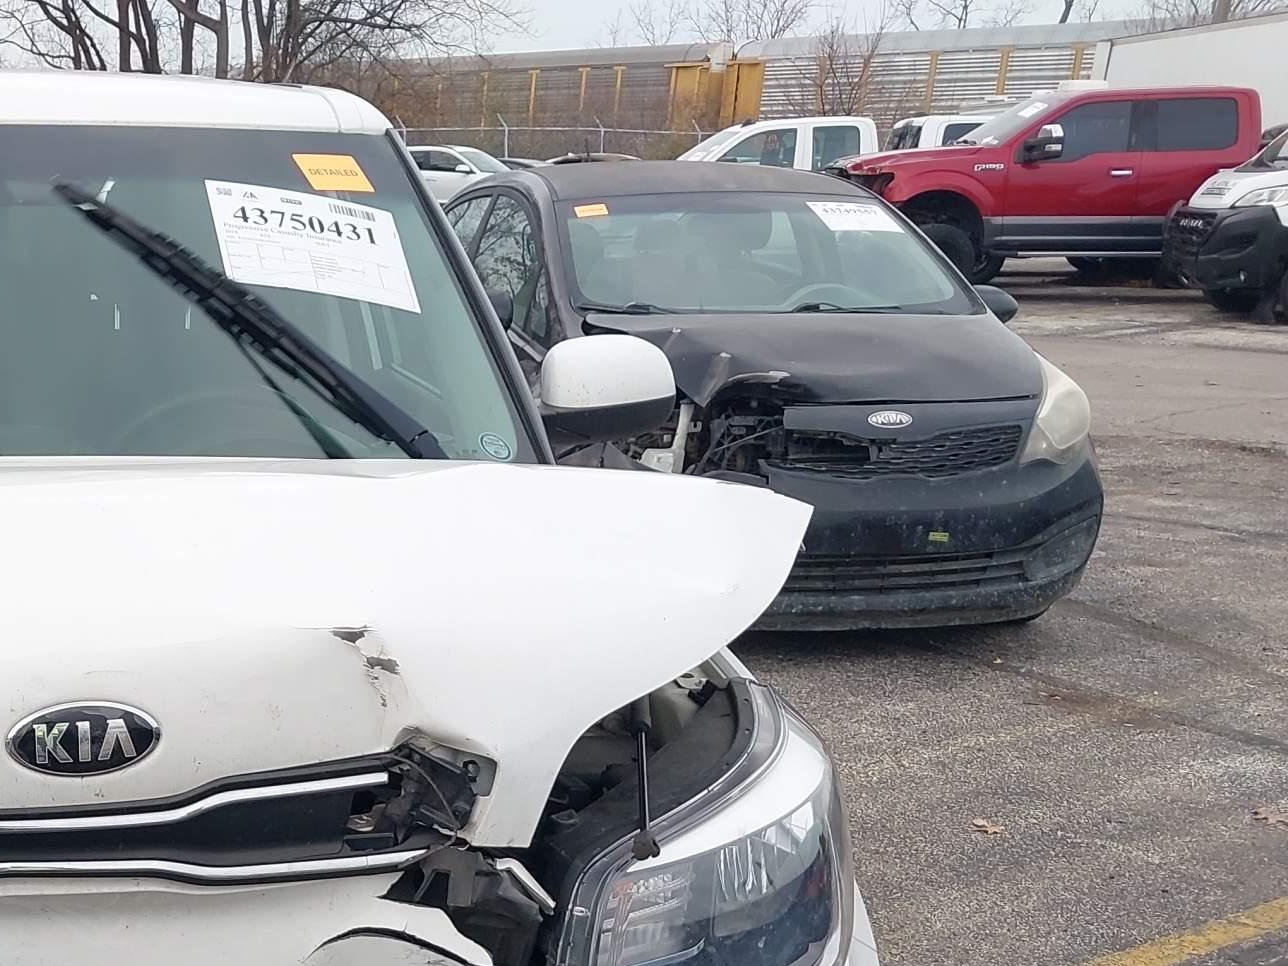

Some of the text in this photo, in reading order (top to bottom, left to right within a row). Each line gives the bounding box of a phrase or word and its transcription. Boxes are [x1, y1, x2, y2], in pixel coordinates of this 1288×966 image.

[308, 167, 359, 178] DETAILED
[232, 205, 379, 246] 43750431
[32, 718, 137, 764] KIA
